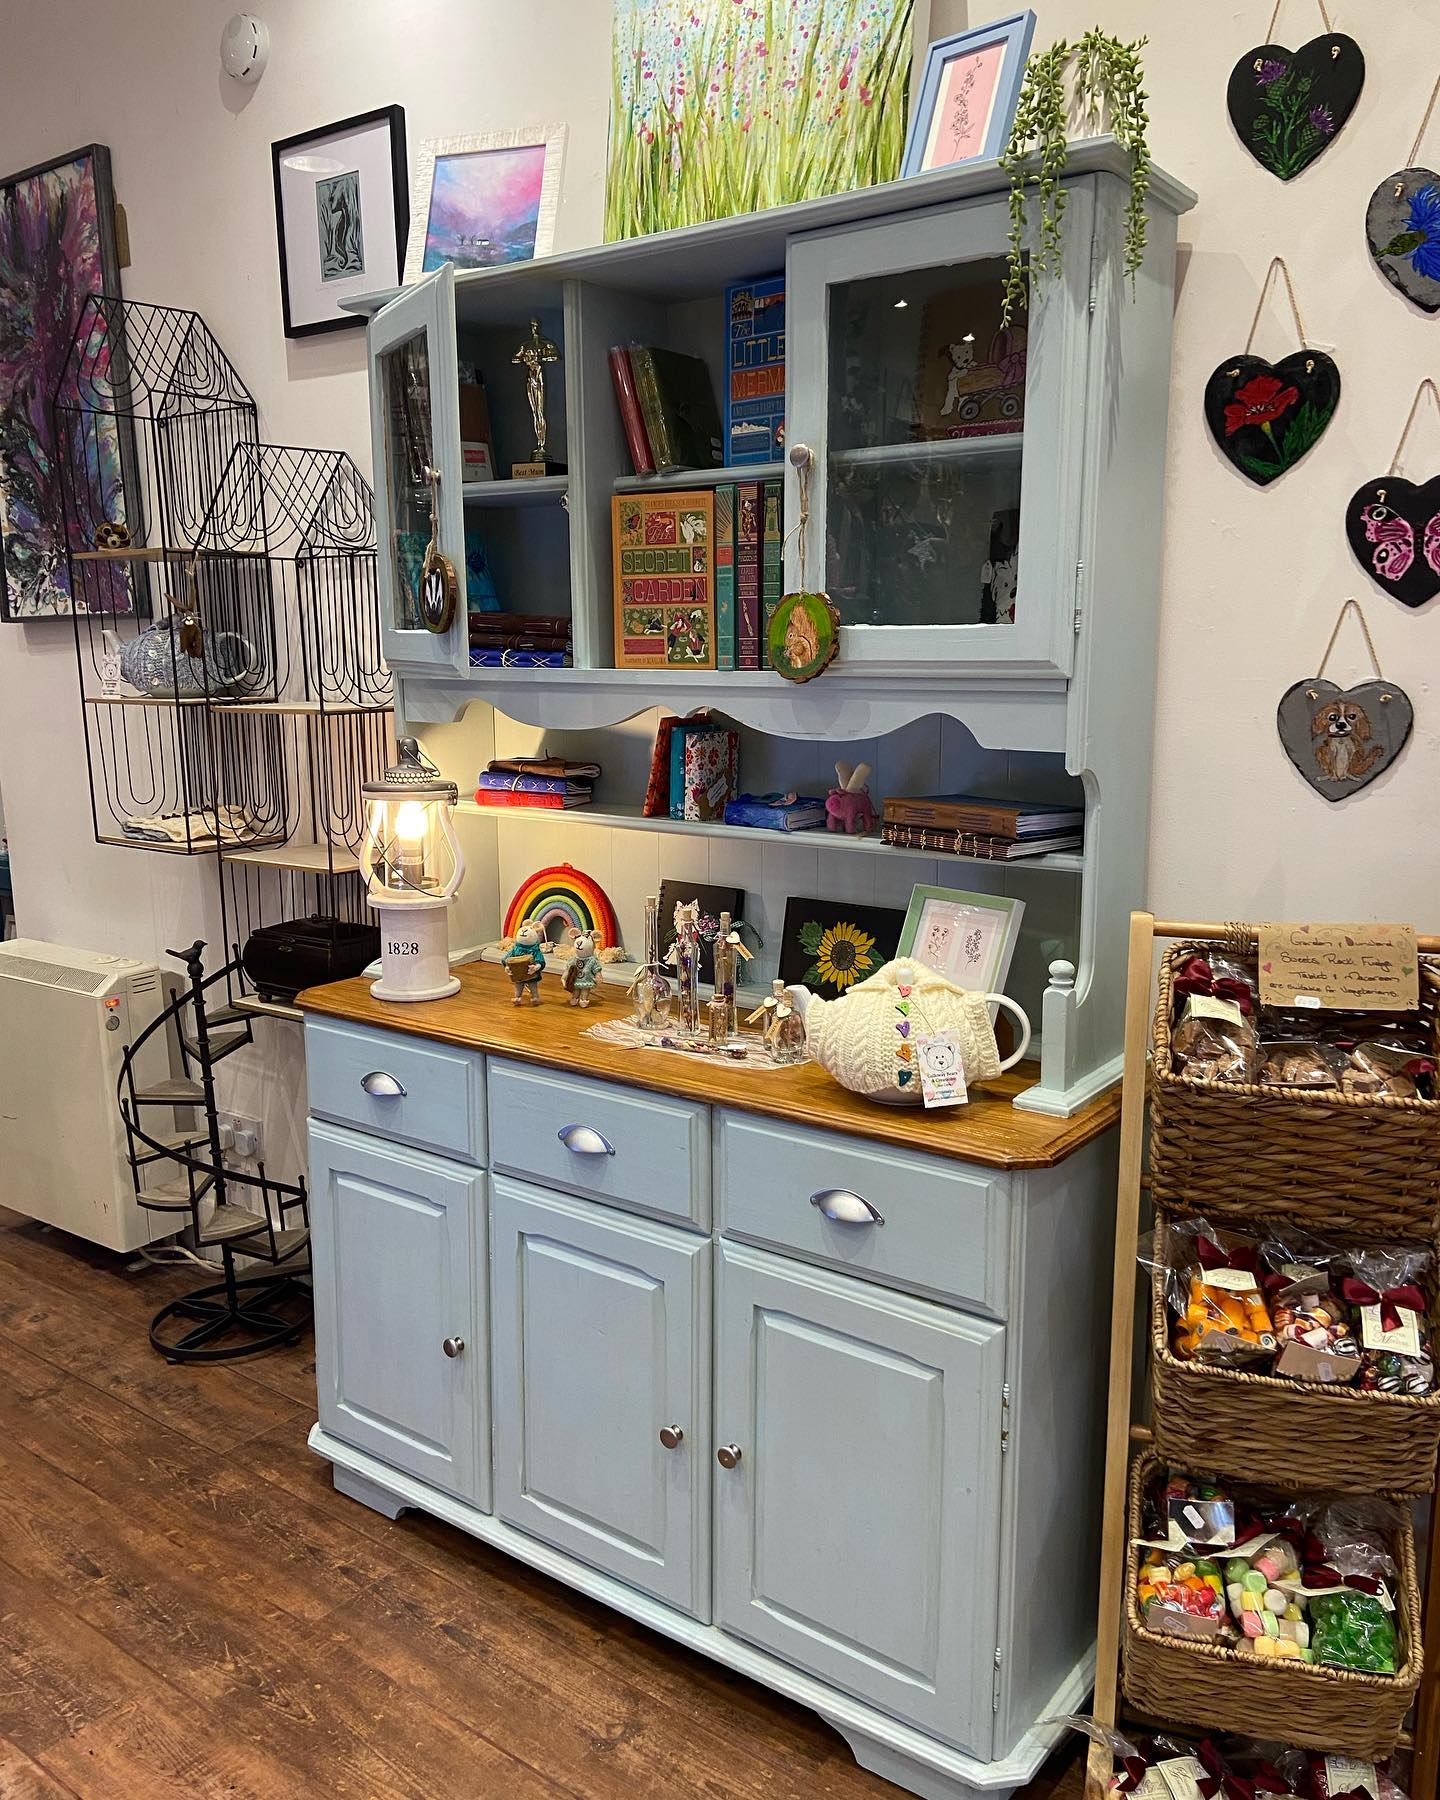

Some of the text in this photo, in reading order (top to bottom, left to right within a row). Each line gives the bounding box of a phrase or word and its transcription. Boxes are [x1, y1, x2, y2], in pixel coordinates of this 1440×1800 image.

[733, 335, 785, 368] LITTLE
[513, 467, 545, 477] Best Mum
[622, 549, 690, 573] SECRET
[633, 578, 707, 602] GARDEN
[388, 942, 419, 955] 1828
[1280, 951, 1393, 973] Sweets Rock Fudge
[1287, 983, 1322, 993] suitable
[1325, 985, 1336, 993] for
